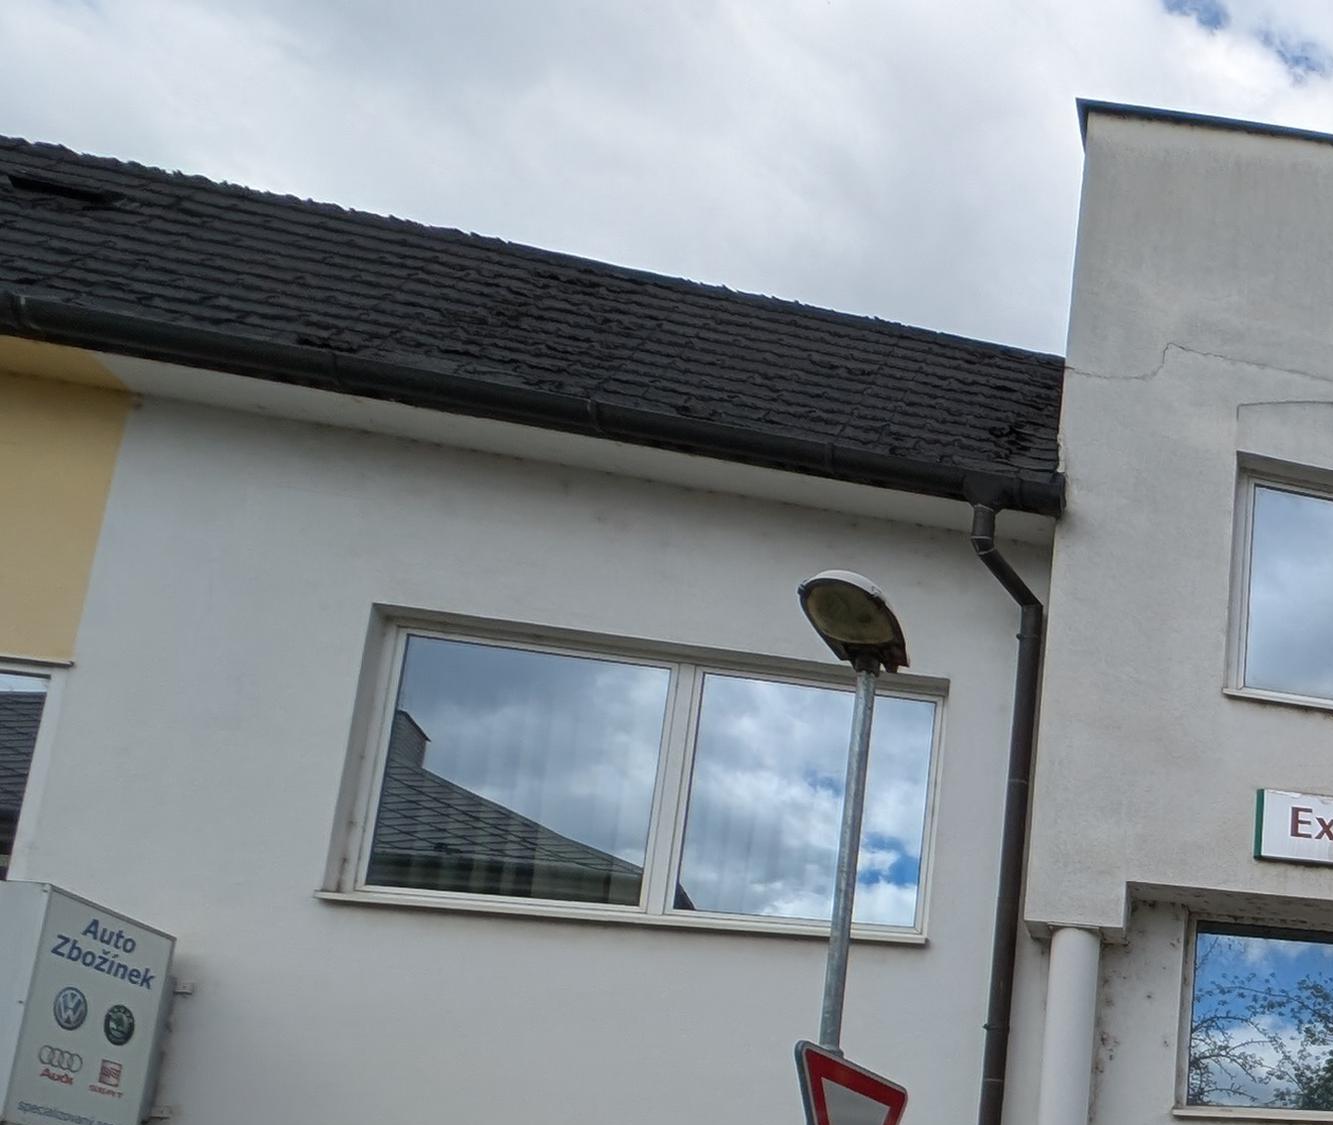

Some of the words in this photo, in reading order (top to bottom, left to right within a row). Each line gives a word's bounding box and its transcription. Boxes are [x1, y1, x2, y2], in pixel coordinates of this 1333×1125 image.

[82, 918, 136, 954] Auto
[51, 934, 156, 990] Zbožínek
[39, 1067, 74, 1086] Audi
